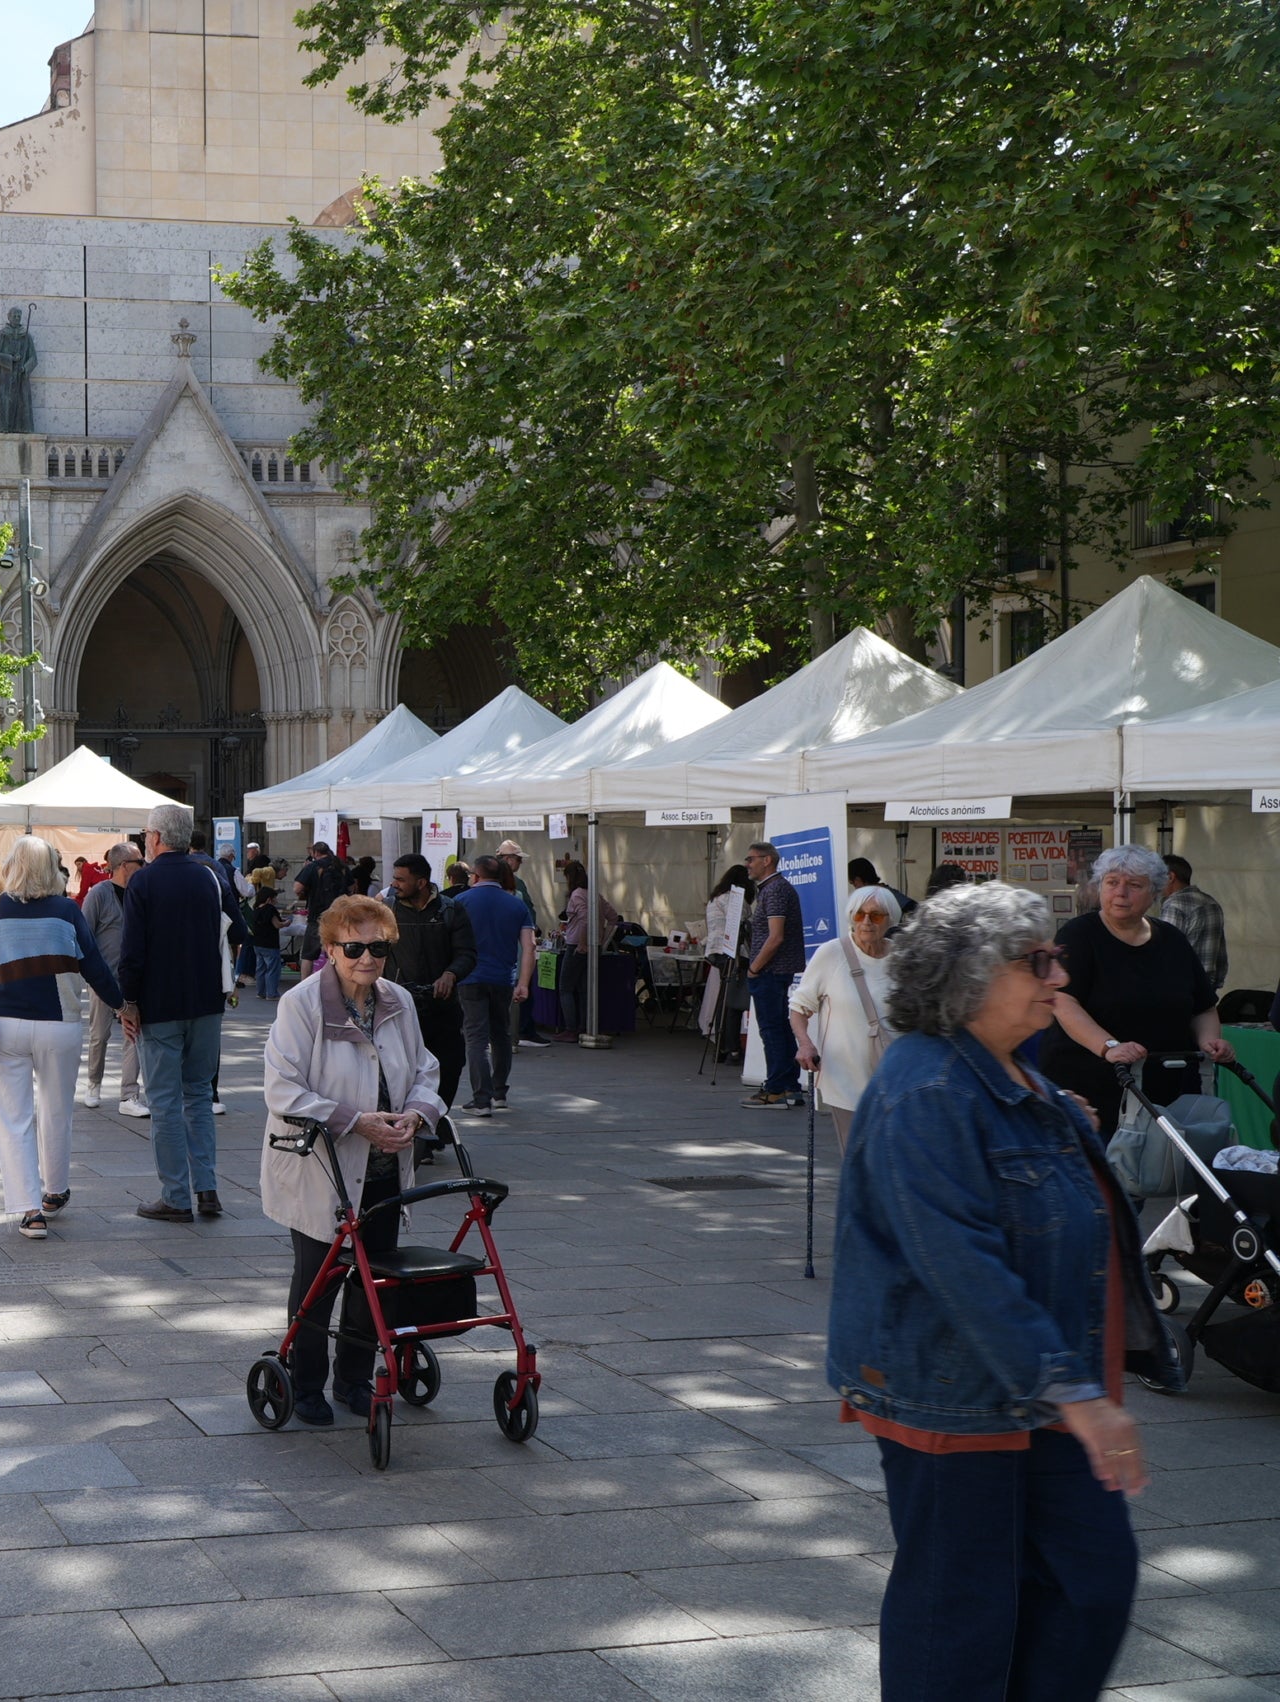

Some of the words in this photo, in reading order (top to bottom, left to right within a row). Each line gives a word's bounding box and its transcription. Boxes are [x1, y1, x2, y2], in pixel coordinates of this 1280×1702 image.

[1260, 795, 1280, 809] Ass
[661, 811, 680, 821] Assoc.
[700, 811, 714, 821] Eira
[909, 805, 950, 816] Alcohòlics
[950, 805, 986, 815] anònims
[941, 831, 1000, 844] PASSEJADES
[1007, 830, 1056, 845] POETITZA
[1059, 830, 1071, 844] LA
[1012, 847, 1039, 860] TEVA
[1040, 847, 1067, 860] VIDA
[776, 853, 824, 872] Alcohólicos
[784, 871, 818, 886] ónimos
